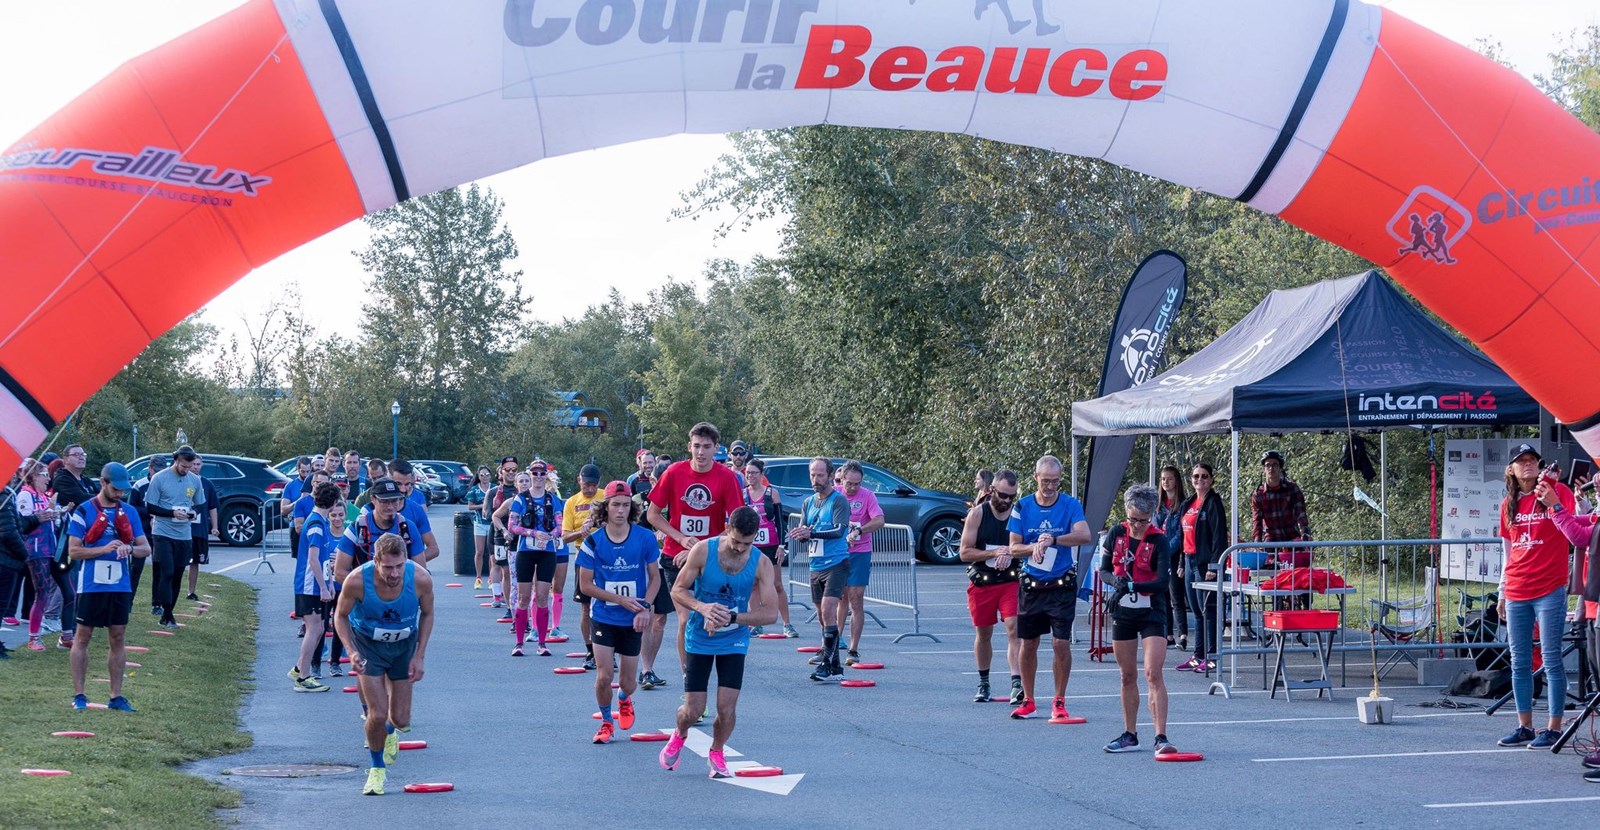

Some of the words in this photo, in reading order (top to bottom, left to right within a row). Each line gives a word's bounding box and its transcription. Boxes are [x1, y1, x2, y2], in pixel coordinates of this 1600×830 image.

[503, 0, 819, 47] Courir
[734, 53, 786, 90] la
[795, 25, 1168, 101] Beauce
[63, 176, 128, 192] COURSE
[136, 185, 234, 208] BEAUCERON
[1346, 339, 1386, 347] PASSION
[1344, 362, 1415, 372] COURSE
[1436, 367, 1477, 378] PIED
[1359, 391, 1497, 411] intencité
[1358, 413, 1408, 421] ENTRAÎNEMENT
[1416, 412, 1463, 420] DÉPASSEMENT
[686, 519, 703, 533] 30
[754, 531, 765, 542] 29
[106, 564, 112, 580] 1
[613, 585, 630, 597] 10
[381, 632, 401, 643] 31
